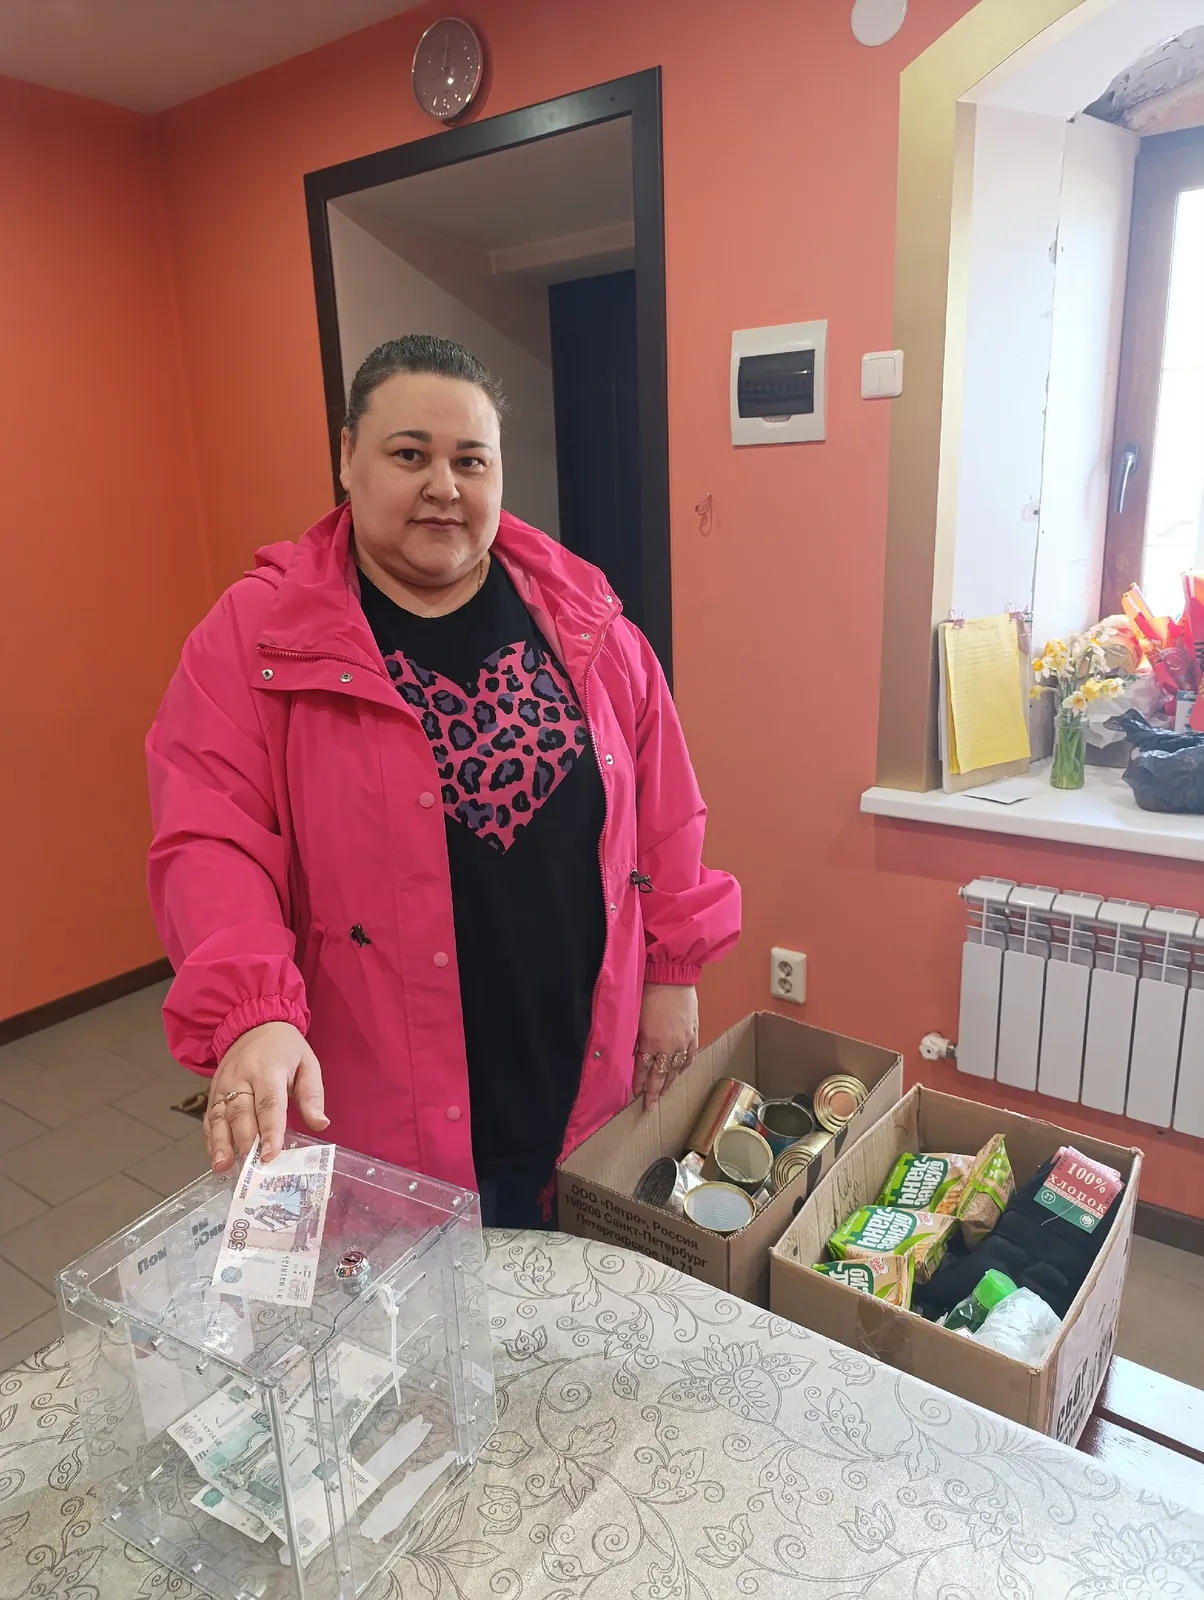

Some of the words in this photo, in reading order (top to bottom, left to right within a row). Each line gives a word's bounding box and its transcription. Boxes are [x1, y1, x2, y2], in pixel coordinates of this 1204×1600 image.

[1047, 1173, 1107, 1214] ХЛОПОК
[1067, 1162, 1108, 1194] 100%
[1043, 1192, 1054, 1201] 27
[571, 1184, 597, 1204] ООО
[653, 1221, 698, 1251] Россия
[227, 1218, 250, 1252] 500
[604, 1211, 708, 1268] Санкт-Петербург
[679, 1260, 693, 1275] 71
